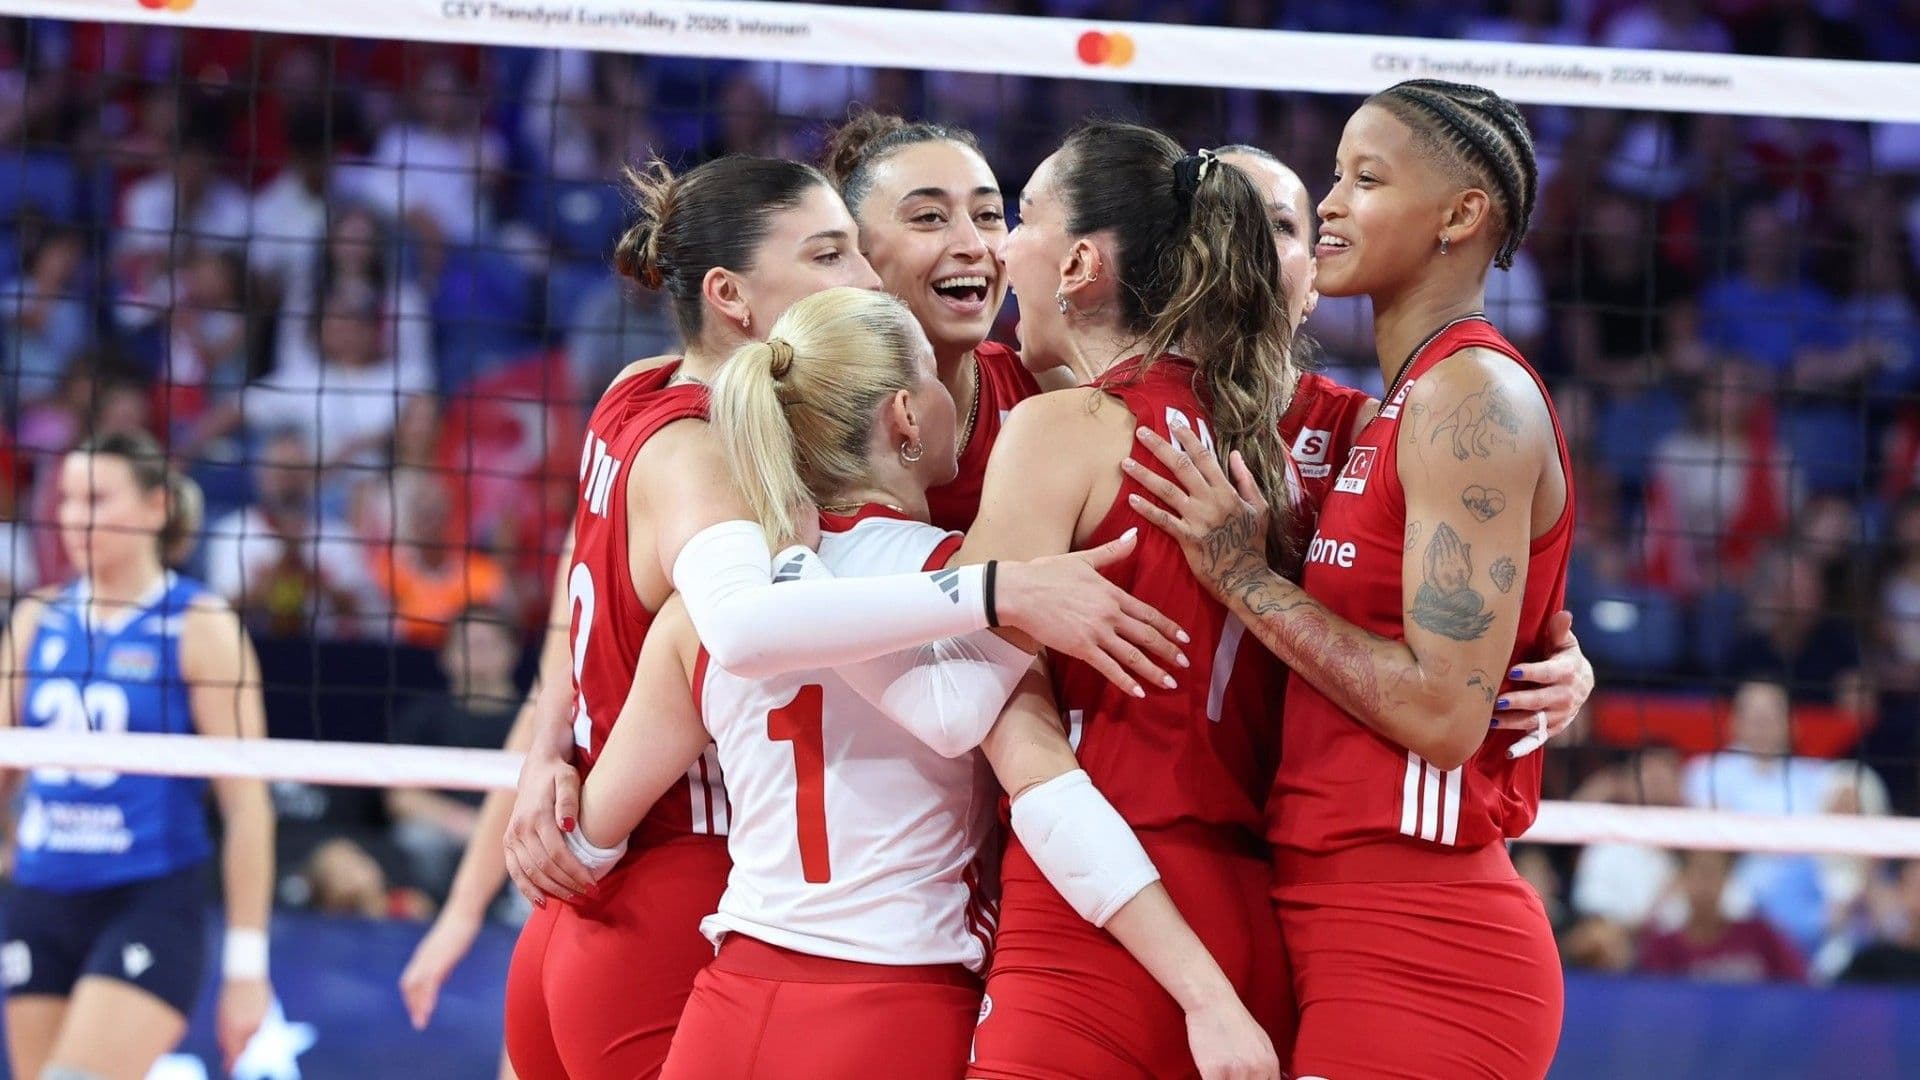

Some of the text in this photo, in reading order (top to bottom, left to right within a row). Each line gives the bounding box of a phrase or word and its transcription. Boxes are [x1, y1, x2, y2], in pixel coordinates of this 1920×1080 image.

[442, 1, 483, 18] CEV
[1372, 52, 1412, 71] CEV
[1301, 436, 1323, 456] S
[1344, 479, 1358, 490] TUR
[767, 684, 831, 884] 1
